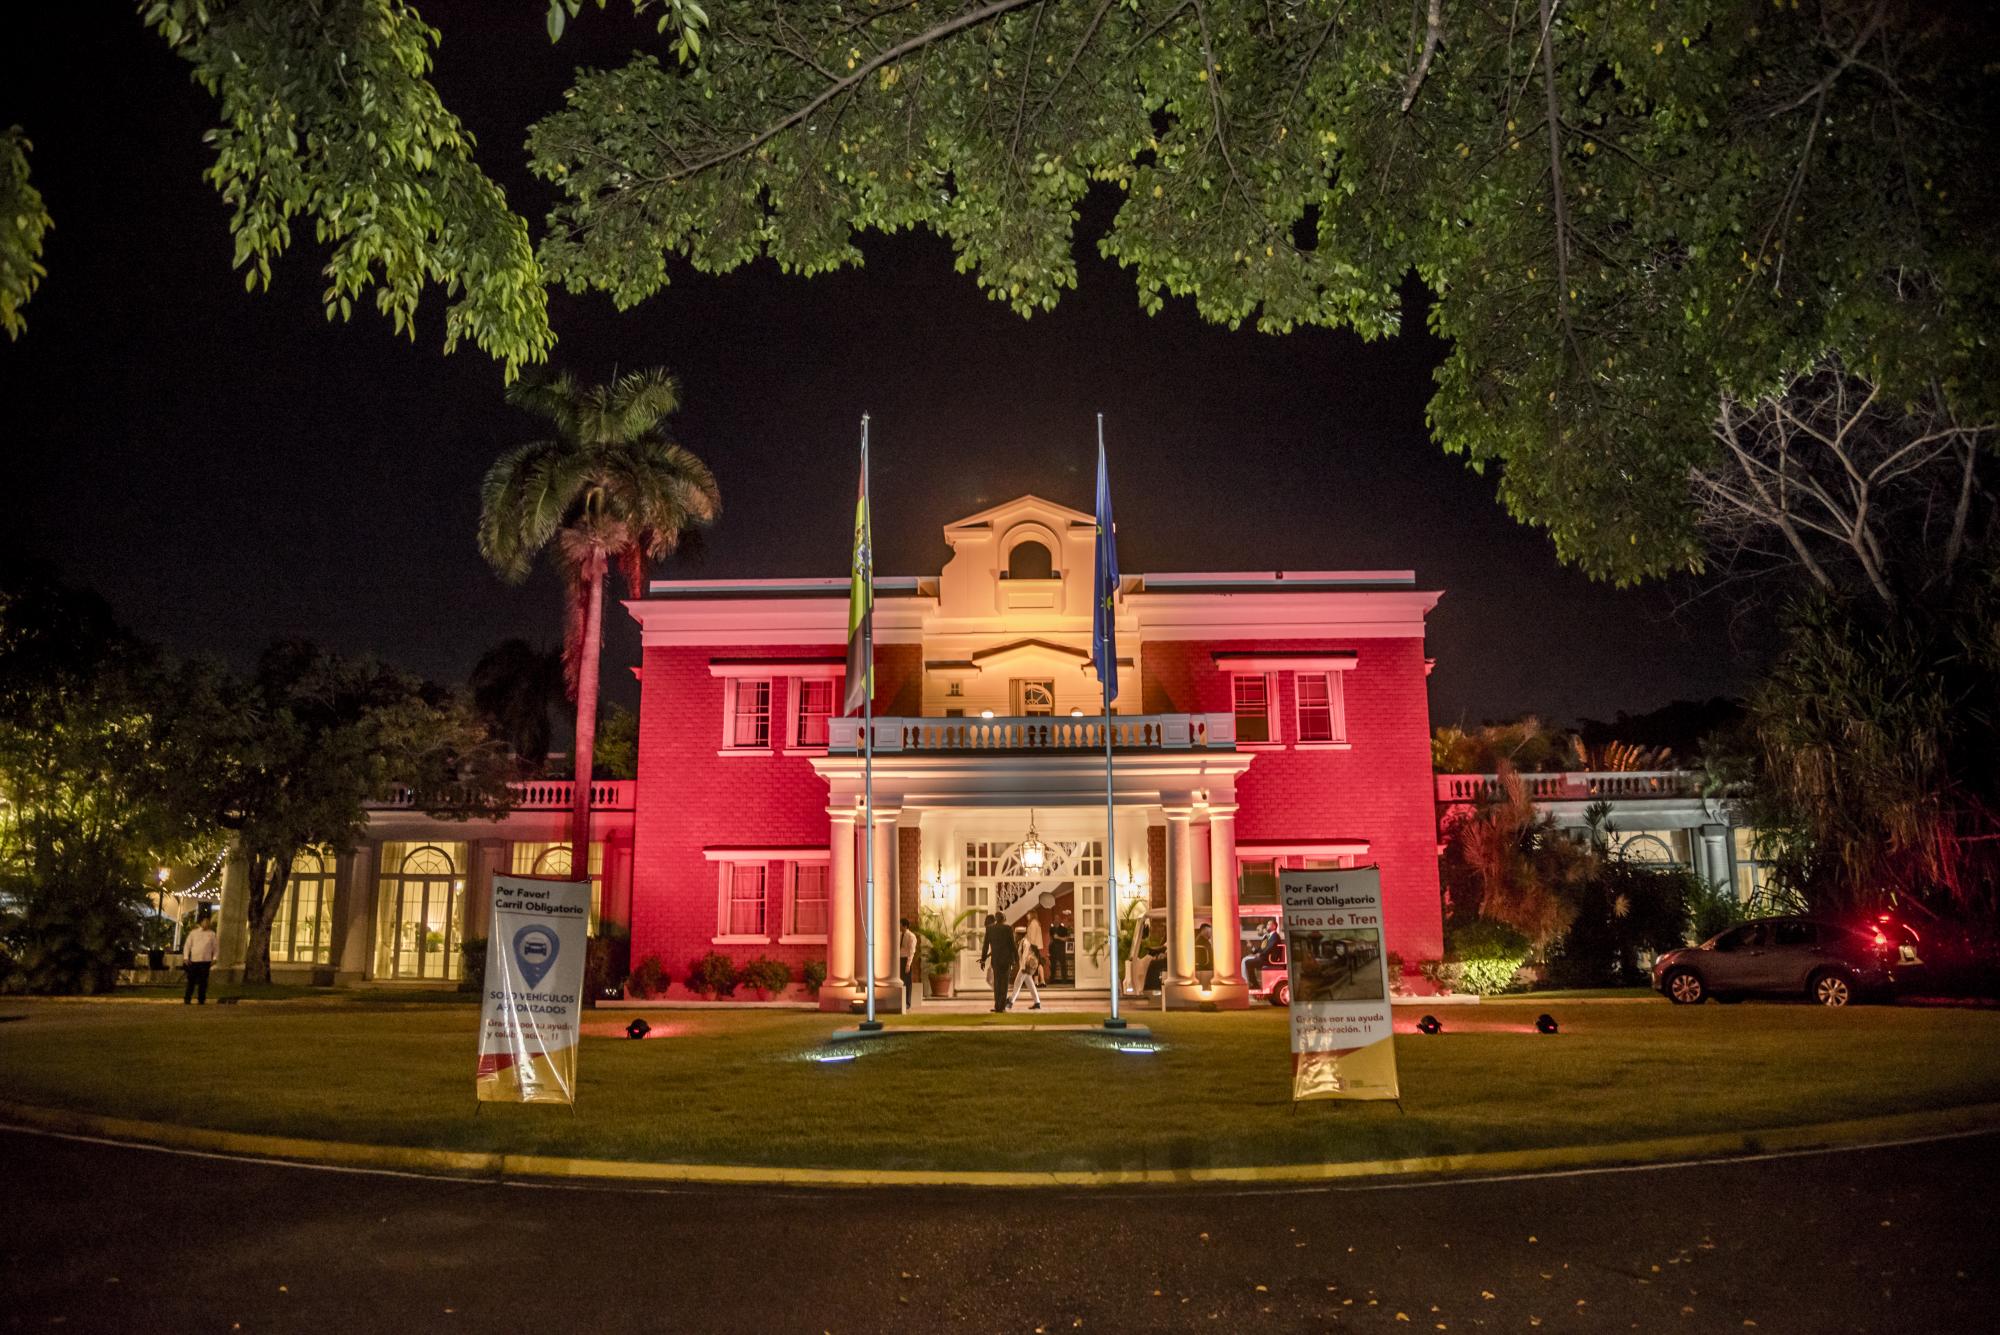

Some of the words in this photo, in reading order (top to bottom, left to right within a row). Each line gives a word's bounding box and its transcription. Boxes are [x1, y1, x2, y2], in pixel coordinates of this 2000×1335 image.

[496, 886, 514, 896] Por
[517, 888, 550, 899] Favor!
[1285, 884, 1303, 893] Por
[1306, 883, 1339, 893] Favor!
[495, 899, 523, 910] Carril
[525, 901, 584, 914] Obligatorio
[1286, 896, 1314, 906] Carril
[1316, 894, 1375, 907] Obligatorio
[1327, 913, 1344, 925] de
[1347, 913, 1377, 925] Tren
[496, 1003, 567, 1014] AORIZADOS
[1358, 1013, 1384, 1024] ayuda
